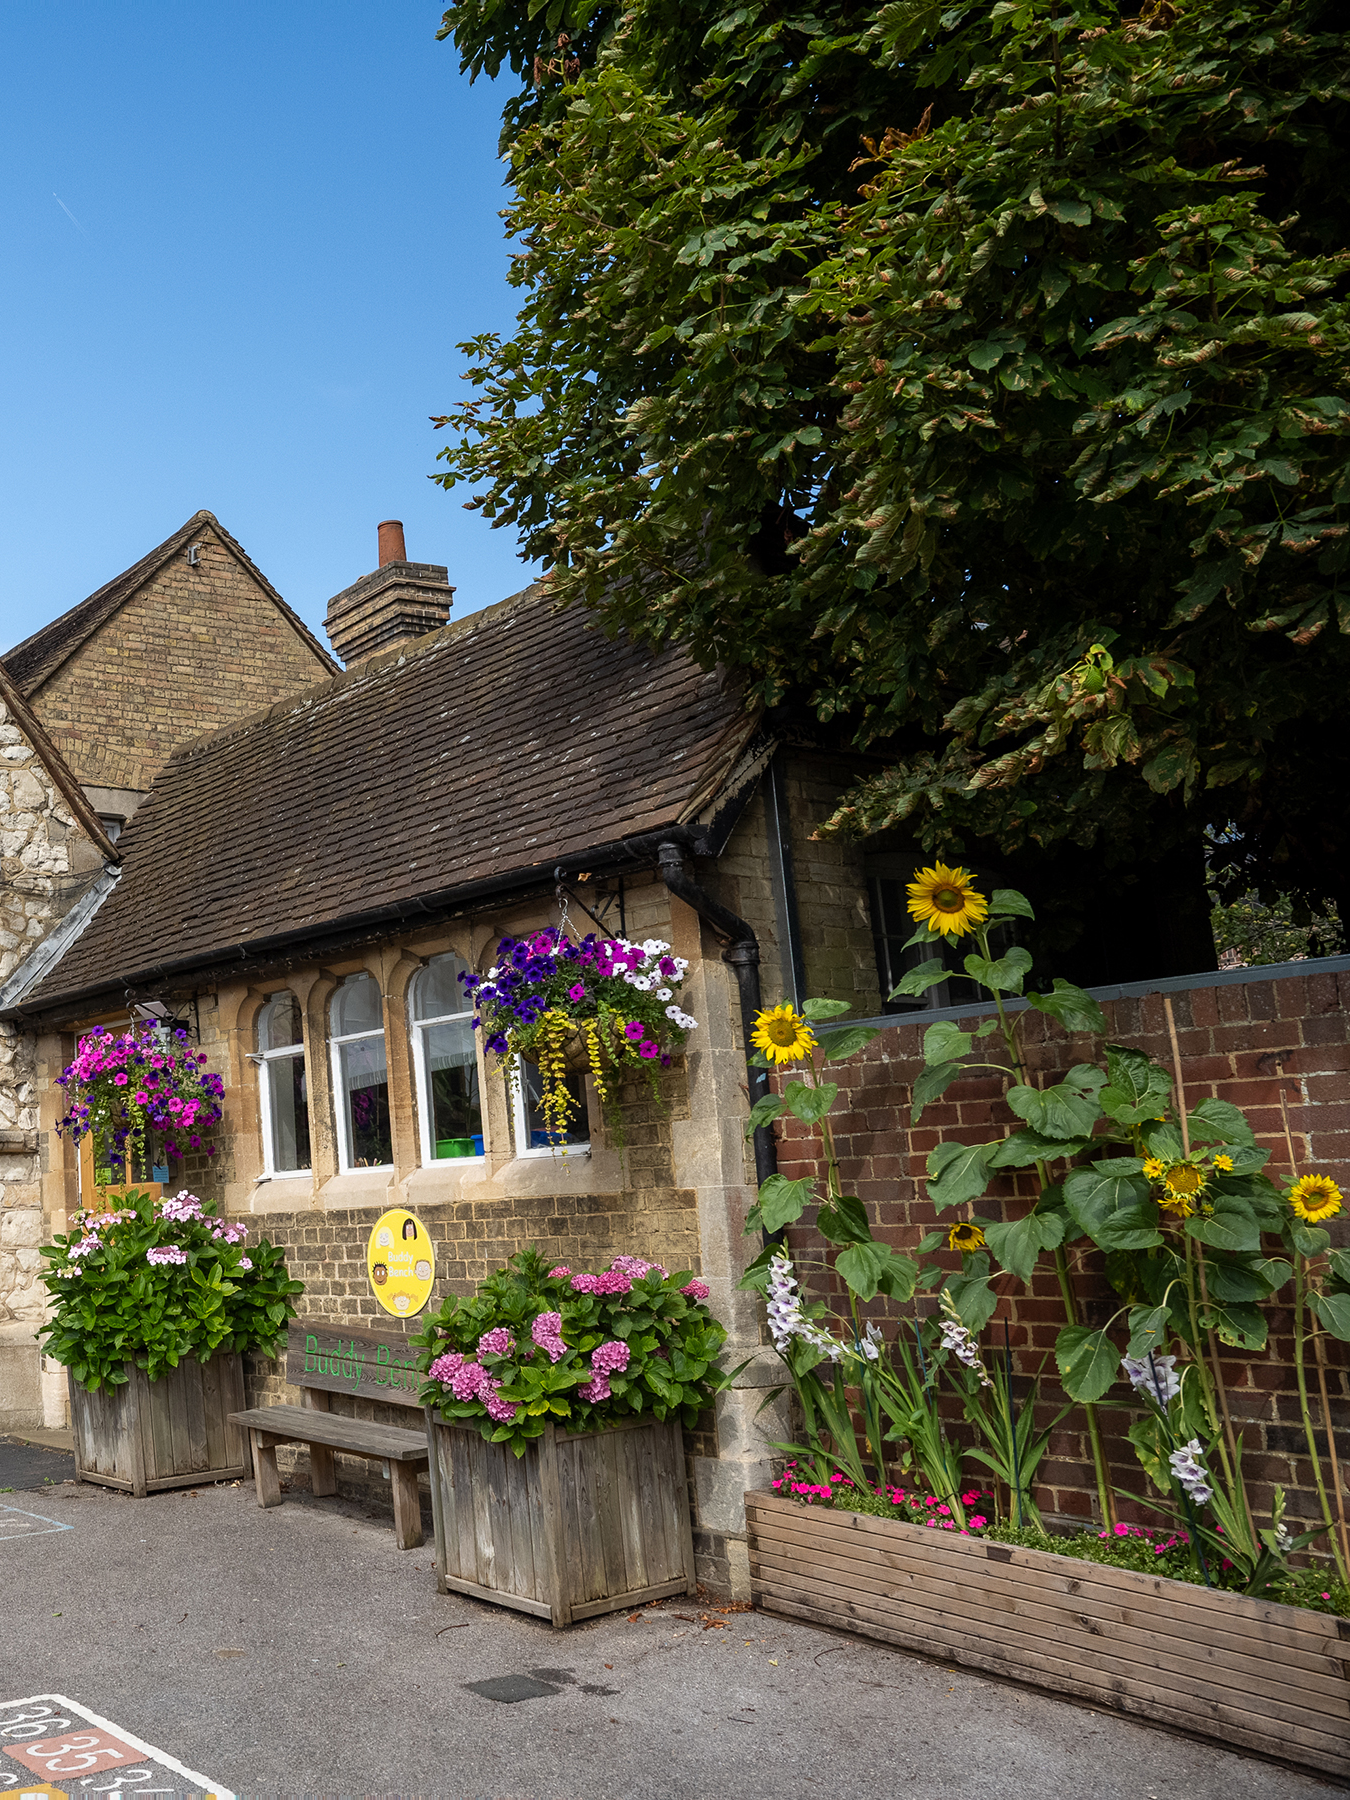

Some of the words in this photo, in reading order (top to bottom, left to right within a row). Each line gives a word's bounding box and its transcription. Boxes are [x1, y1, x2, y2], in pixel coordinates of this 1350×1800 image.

[388, 1251, 413, 1264] Buddy
[389, 1266, 413, 1277] Bench
[305, 1335, 365, 1391] Buddy
[376, 1344, 434, 1392] Ben
[25, 1736, 125, 1772] 35
